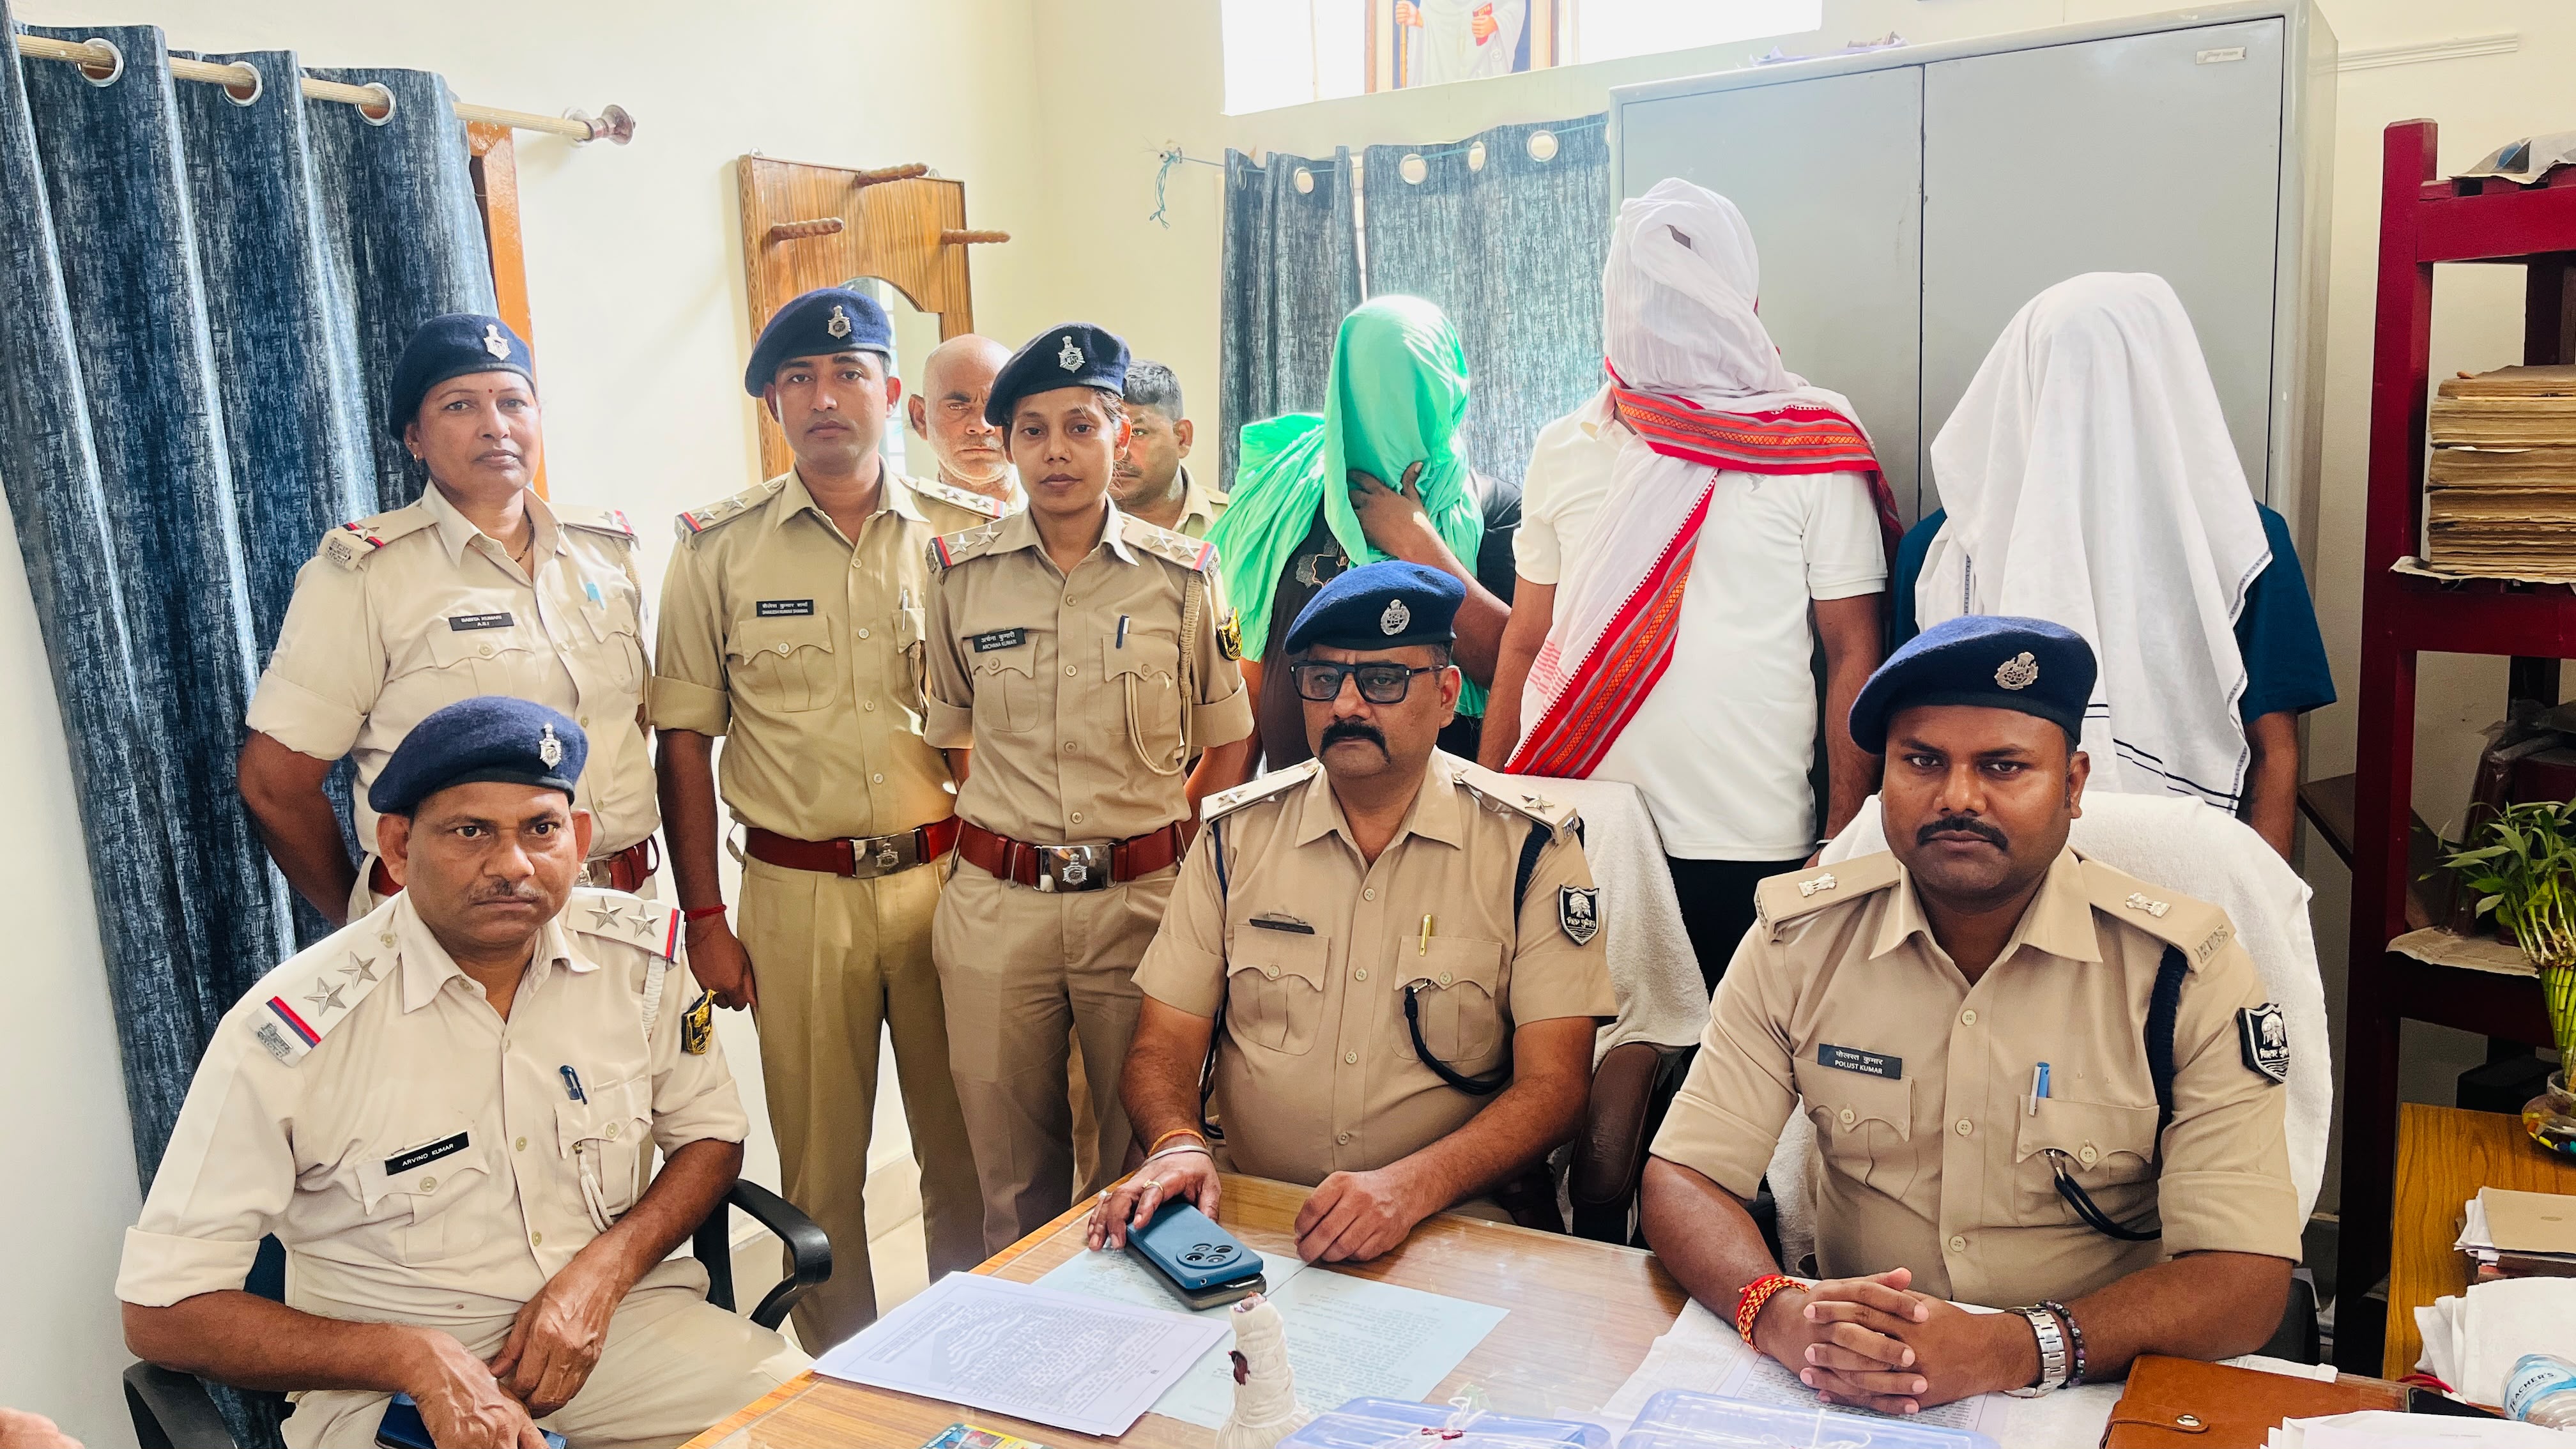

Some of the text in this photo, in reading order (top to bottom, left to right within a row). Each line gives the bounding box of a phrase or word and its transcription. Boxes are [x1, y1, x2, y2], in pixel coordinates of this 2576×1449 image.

[1834, 1059, 1883, 1074] POLUST KUMAR
[1863, 1055, 1883, 1065] कुमार
[402, 1143, 454, 1167] ARVIND KUMAR
[2509, 1373, 2554, 1413] TEACHER'S
